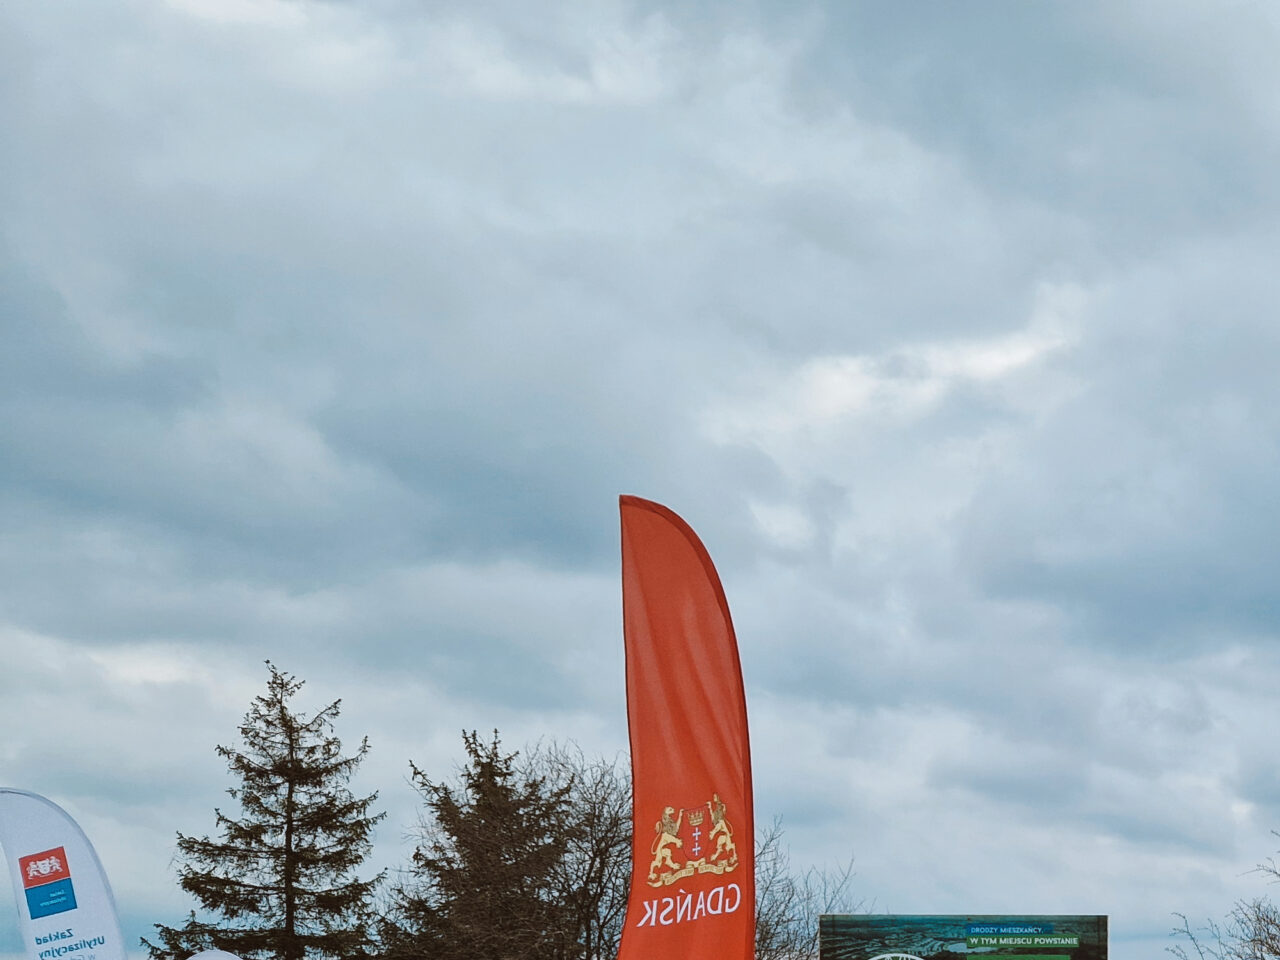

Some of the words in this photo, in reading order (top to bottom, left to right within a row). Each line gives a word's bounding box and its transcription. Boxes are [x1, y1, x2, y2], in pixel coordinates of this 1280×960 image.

[970, 937, 979, 945] W
[981, 937, 997, 945] TYM
[999, 937, 1032, 945] MIEJSCU
[1034, 937, 1079, 945] POWSTANIE
